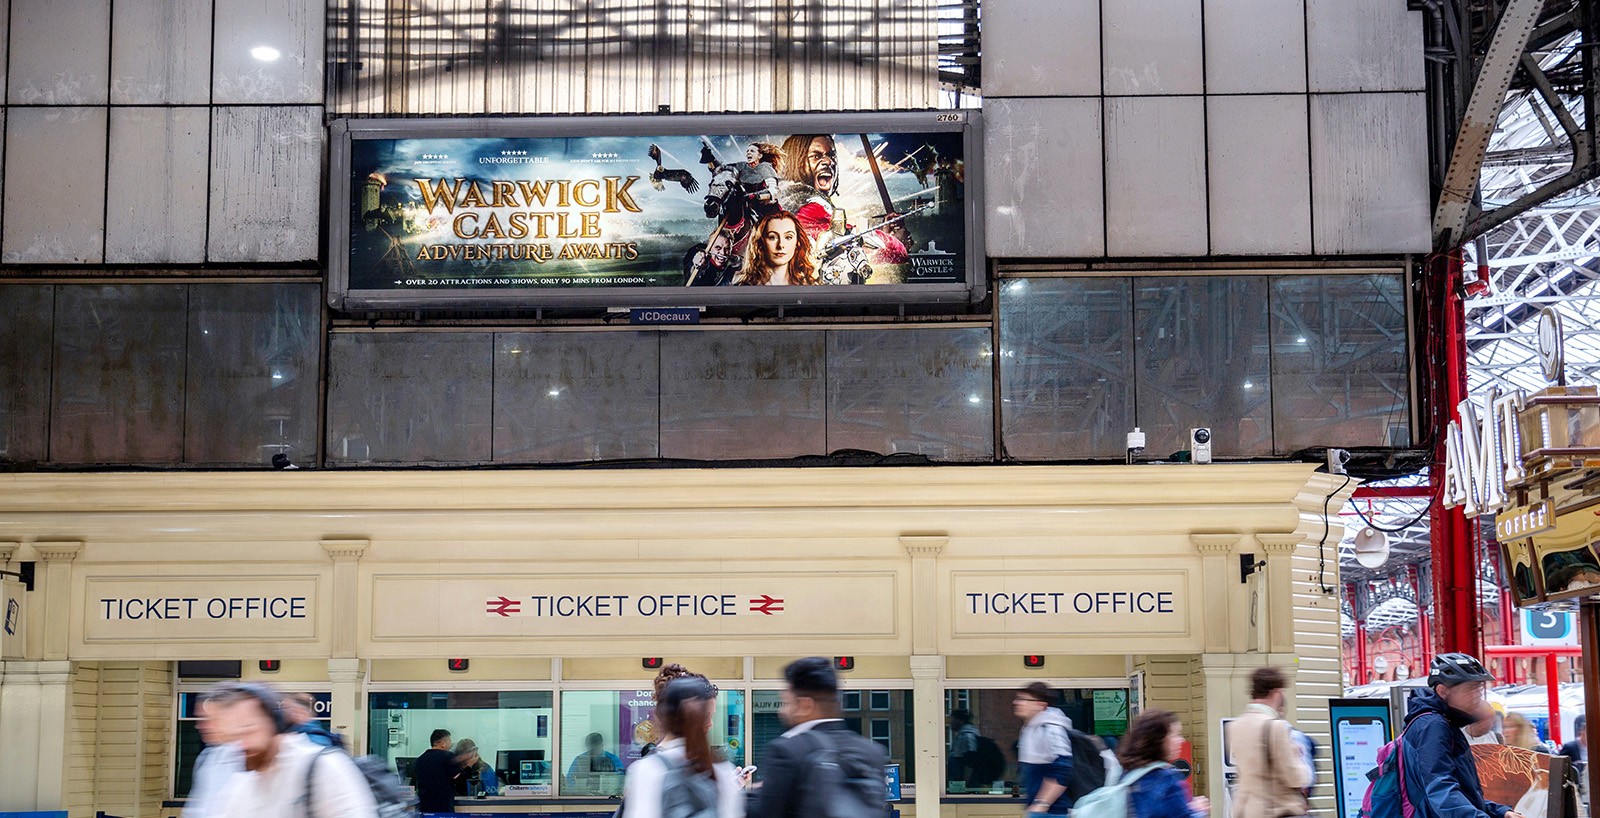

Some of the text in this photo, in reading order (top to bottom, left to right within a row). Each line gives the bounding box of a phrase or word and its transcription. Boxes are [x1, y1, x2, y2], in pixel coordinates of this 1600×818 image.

[937, 113, 958, 121] 2760
[479, 156, 549, 164] UNFORGETTABLE
[414, 175, 643, 214] WARWICK
[452, 211, 603, 239] CASTLE
[416, 242, 639, 264] ADVENTURE AWAITS
[911, 257, 954, 267] WARWICK
[916, 266, 948, 276] CASTLE
[638, 311, 691, 321] JCDecaux
[1443, 384, 1527, 519] AMT
[1497, 508, 1545, 538] COFFEE
[101, 597, 306, 620] TICKET OFFICE
[532, 594, 737, 617] TICKET OFFICE
[966, 592, 1174, 614] TICKET OFFICE
[454, 659, 462, 668] 2
[648, 658, 657, 666] 3
[839, 657, 848, 667] 4
